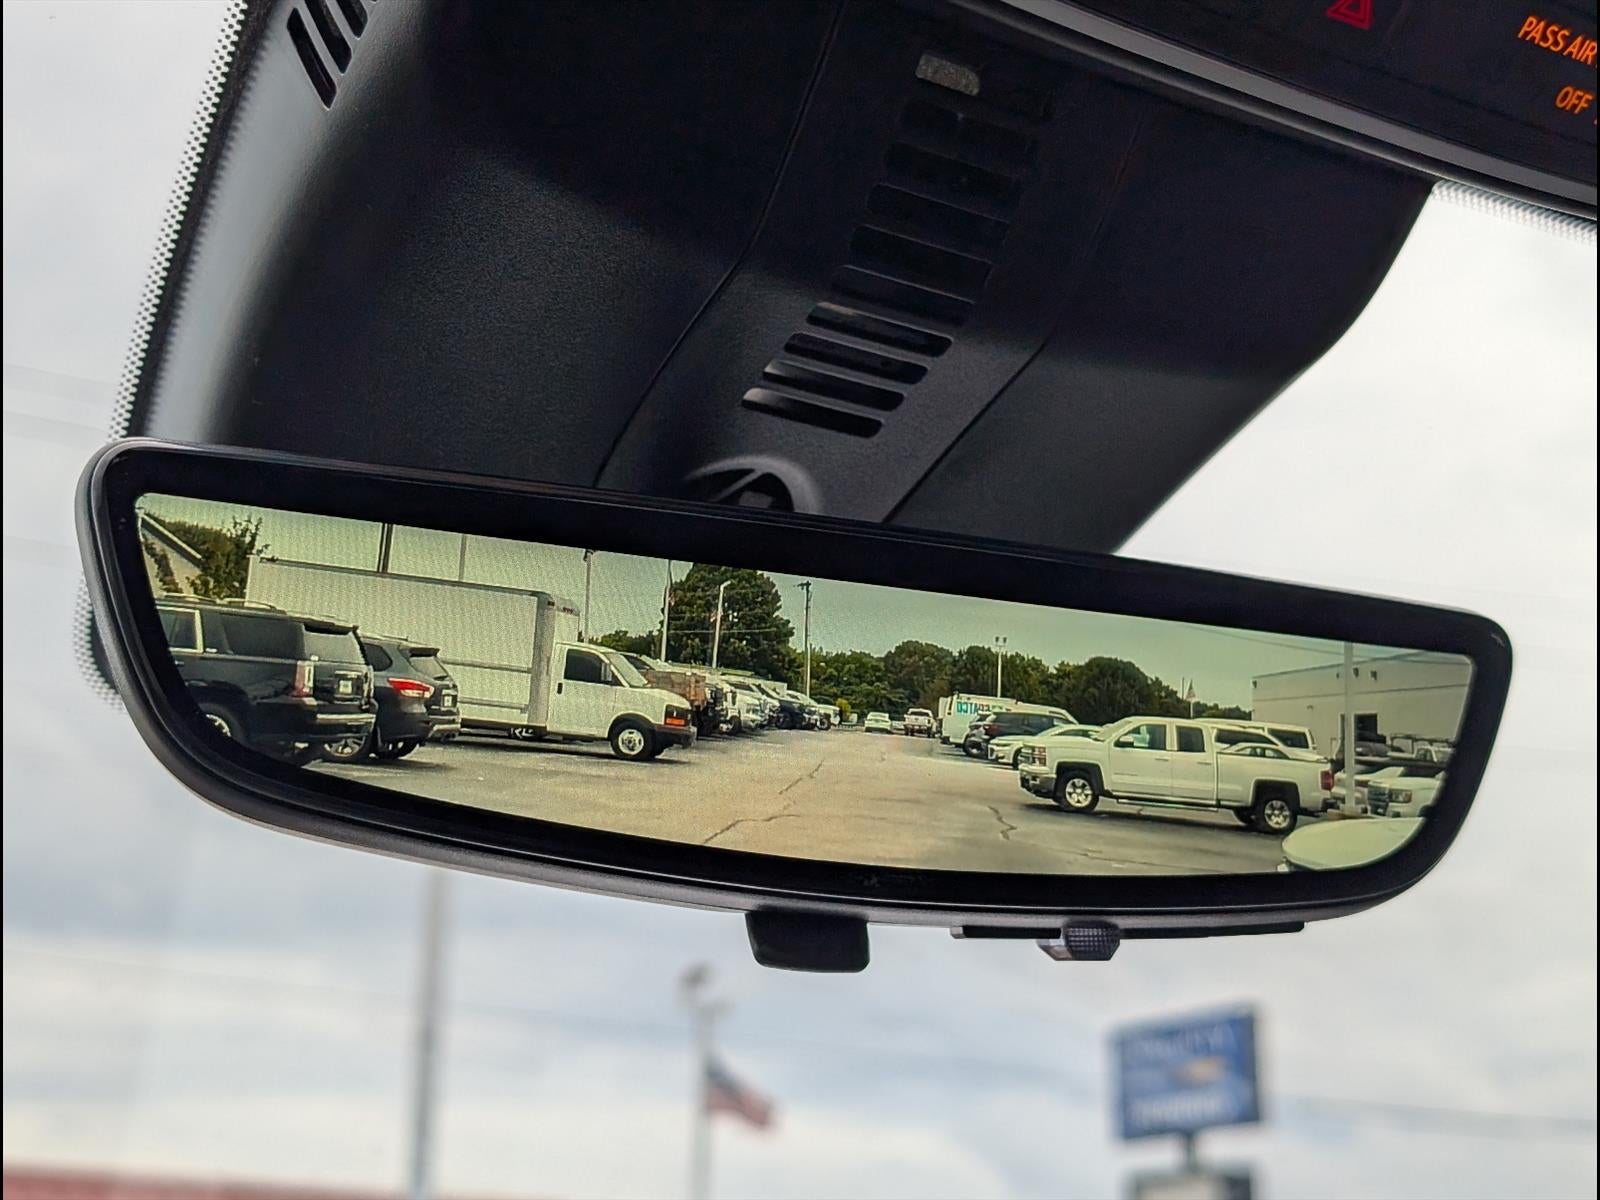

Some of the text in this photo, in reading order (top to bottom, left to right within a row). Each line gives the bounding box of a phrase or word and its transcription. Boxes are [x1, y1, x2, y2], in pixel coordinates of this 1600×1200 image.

[1517, 15, 1597, 66] PASS AIR
[1555, 86, 1593, 114] OFF
